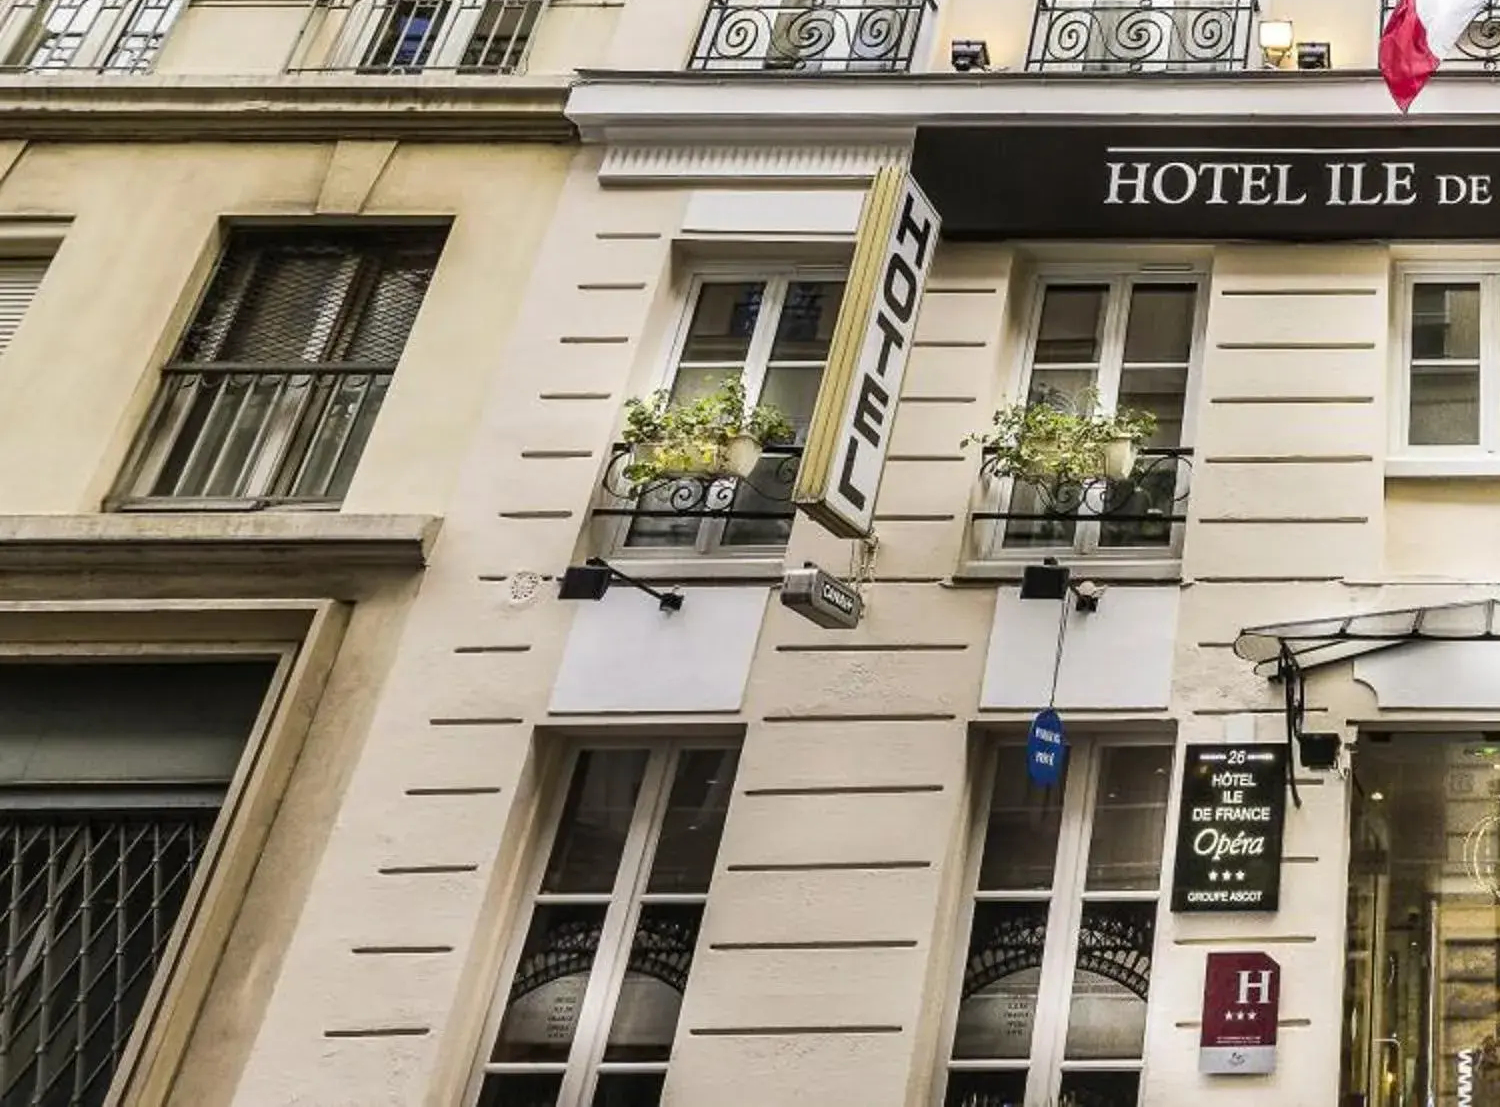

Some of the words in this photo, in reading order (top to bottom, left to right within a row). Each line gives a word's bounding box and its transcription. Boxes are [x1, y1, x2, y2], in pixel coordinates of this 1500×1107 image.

[1103, 162, 1307, 206] HOTEL
[1325, 162, 1417, 206] ILE
[1435, 174, 1493, 205] DE
[837, 192, 932, 511] HOTEL
[1227, 749, 1247, 765] 26
[1211, 771, 1257, 788] HÔTEL
[1221, 789, 1244, 804] ILE
[1192, 806, 1213, 822] DE
[1214, 806, 1271, 822] FRANCE
[1193, 827, 1266, 862] Opéra
[1187, 890, 1228, 902] GROUPE
[1229, 890, 1263, 902] ASCOT
[1237, 970, 1273, 1004] H
